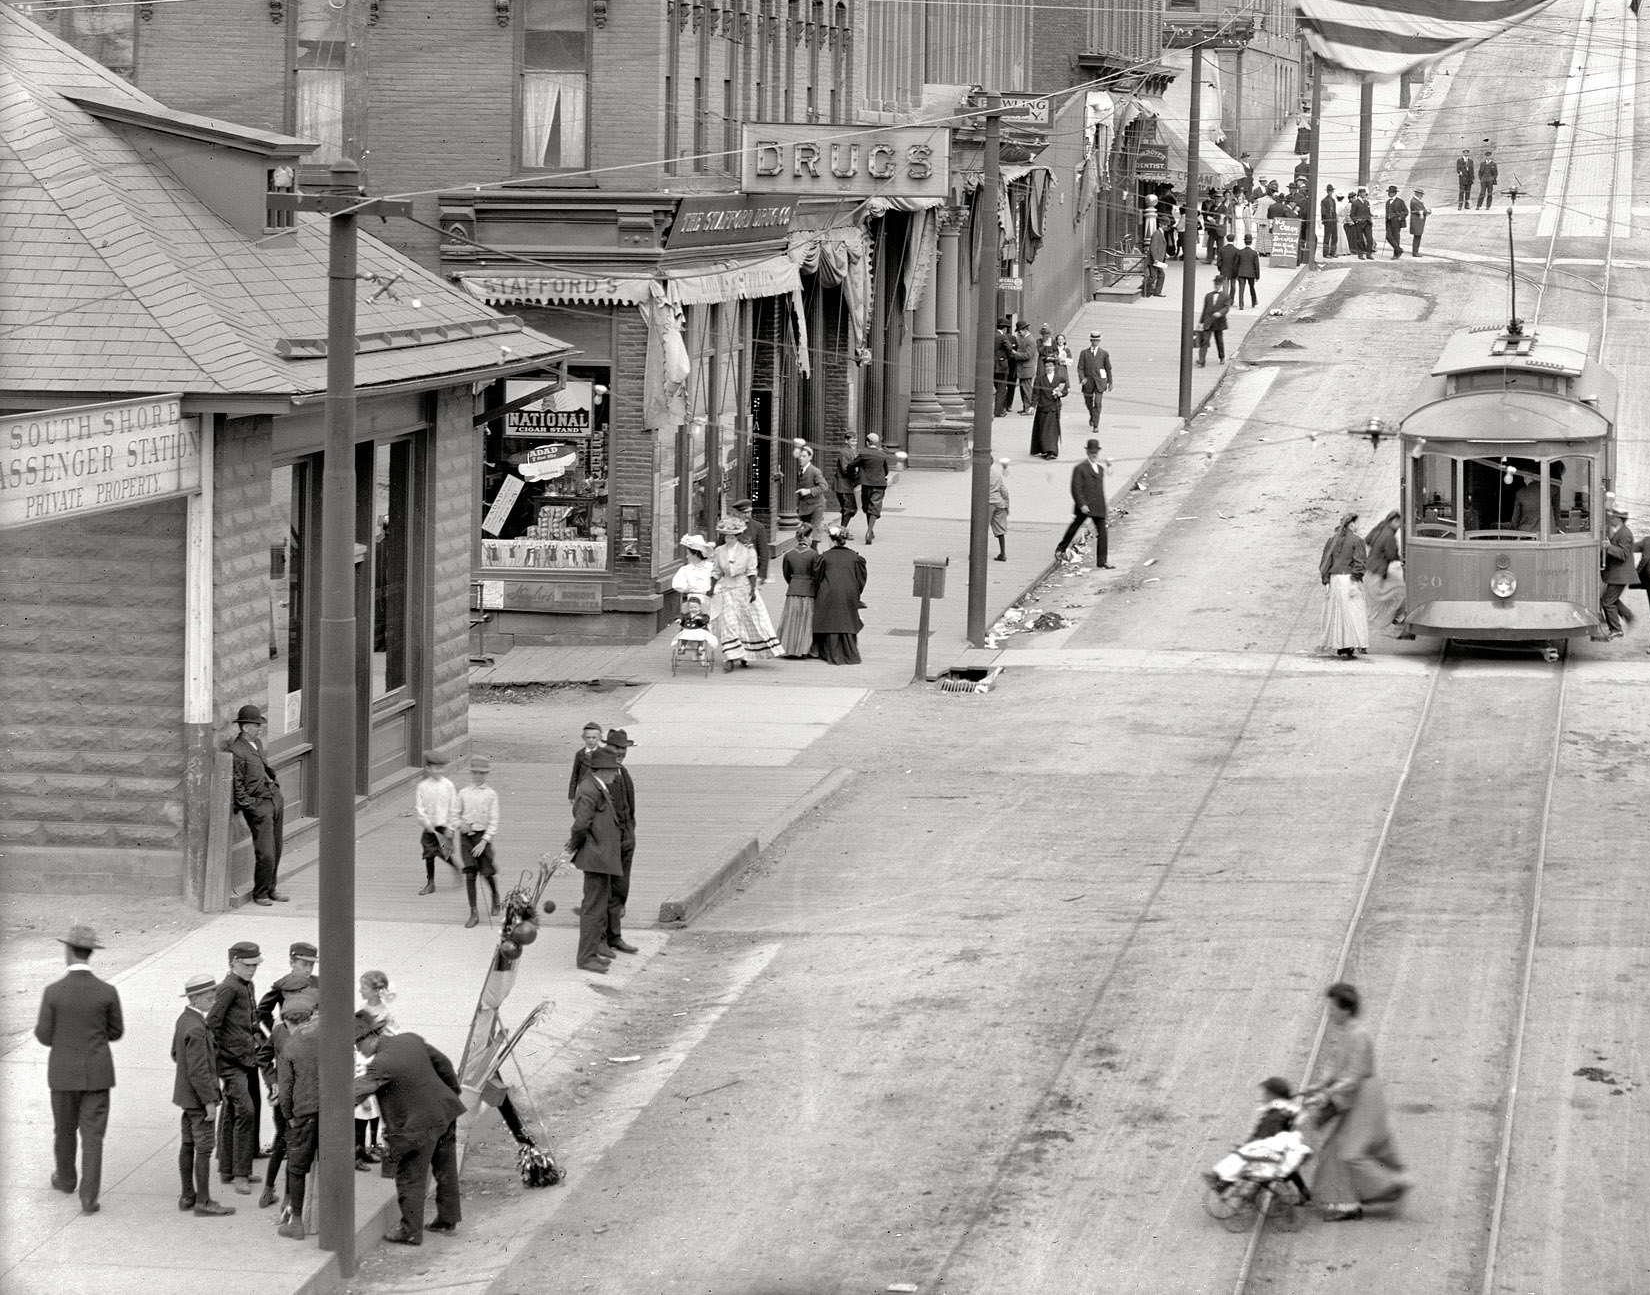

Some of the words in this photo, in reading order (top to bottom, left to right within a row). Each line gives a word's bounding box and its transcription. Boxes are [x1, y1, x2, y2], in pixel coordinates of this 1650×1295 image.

[756, 141, 933, 179] DRUGS
[10, 415, 91, 449] SOUTH
[103, 402, 180, 436] SHORE
[509, 413, 588, 427] NATIONAL
[127, 430, 200, 468] STATION
[25, 487, 84, 518] PRIVATE
[96, 473, 162, 504] PROPERTY.
